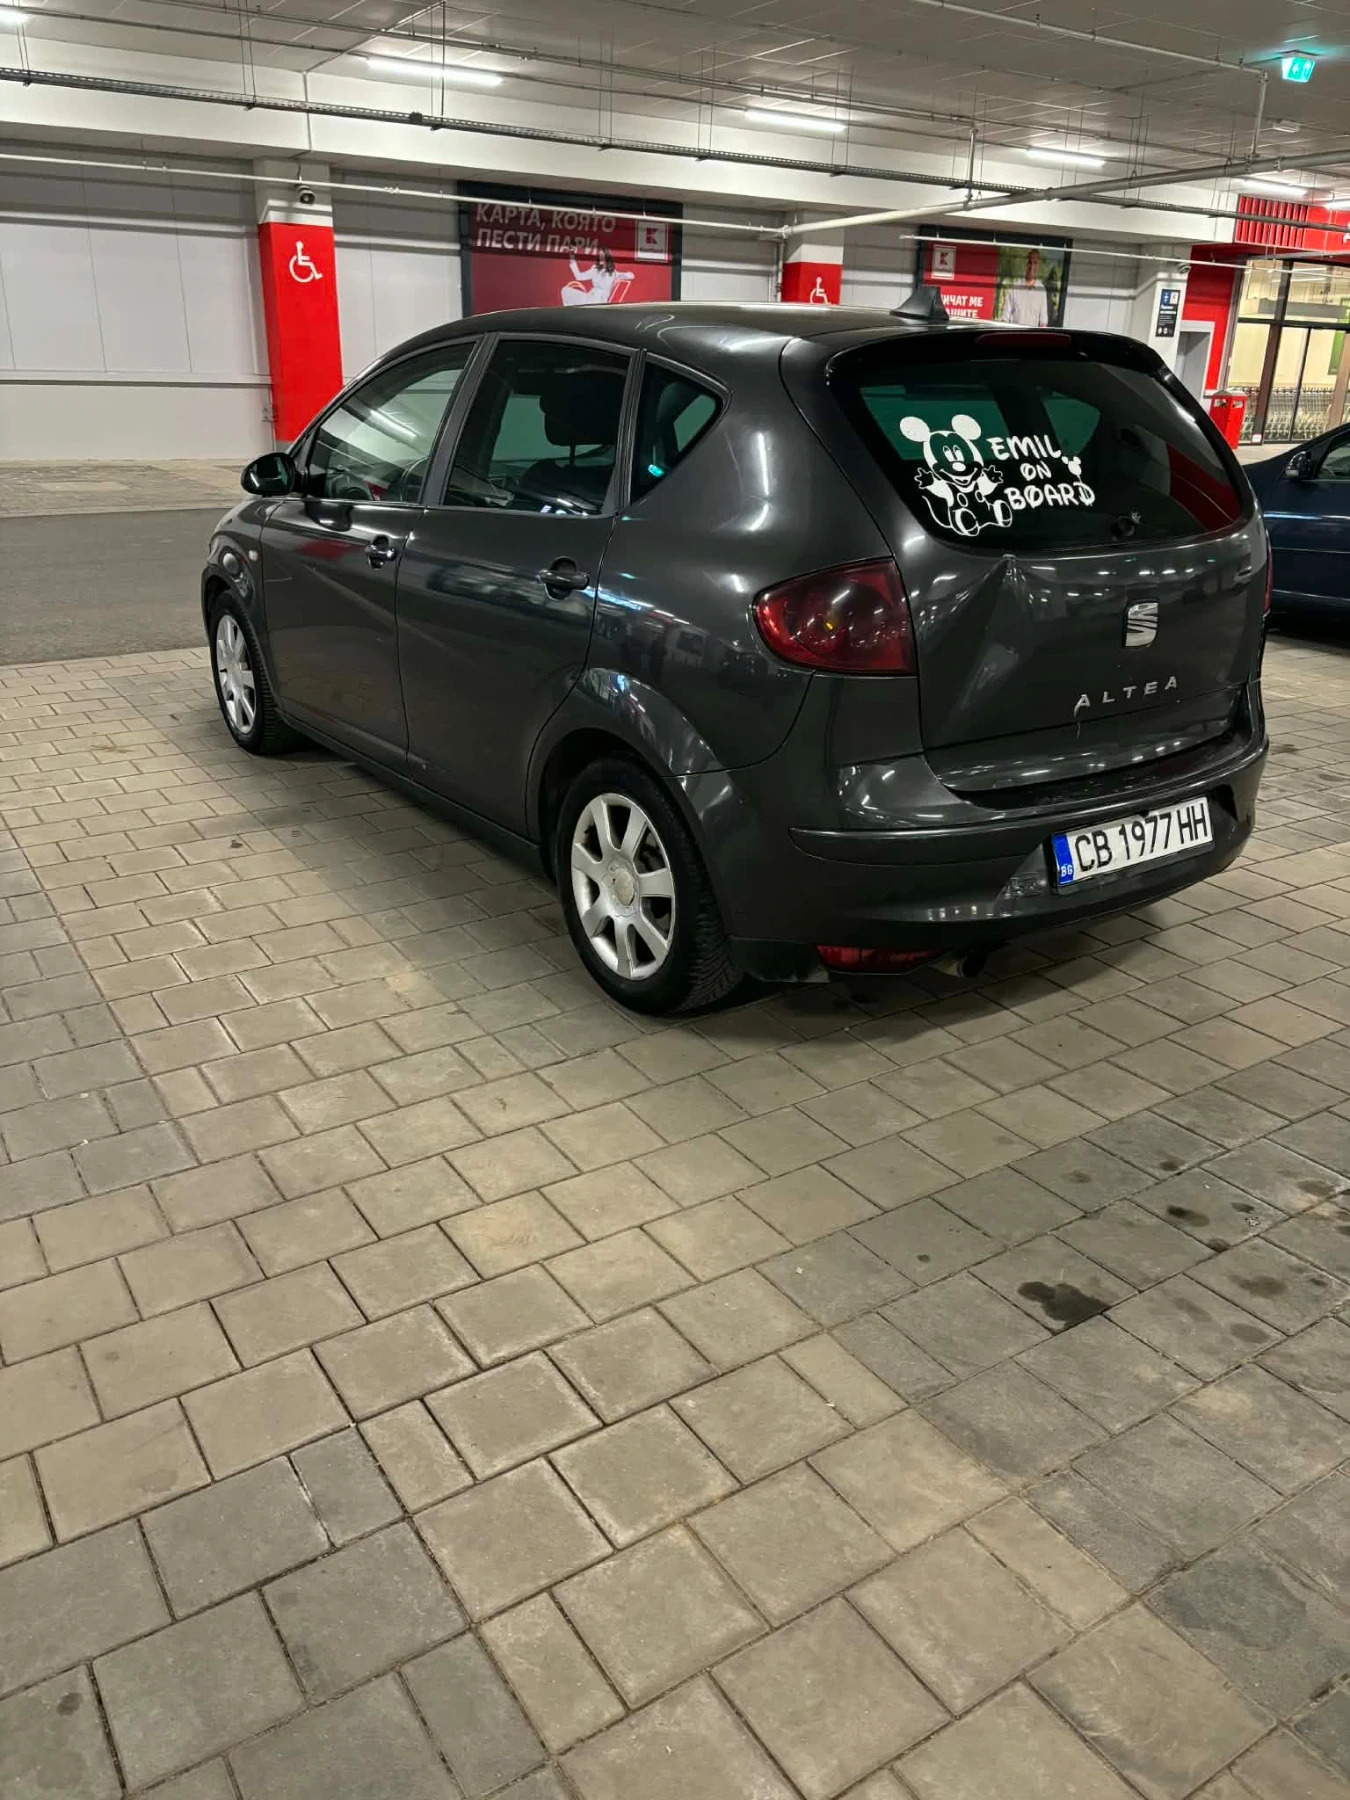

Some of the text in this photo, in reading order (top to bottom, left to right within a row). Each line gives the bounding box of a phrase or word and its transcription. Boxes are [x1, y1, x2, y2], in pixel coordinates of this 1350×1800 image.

[476, 202, 616, 233] КАРТА, КОЯТО
[477, 228, 599, 256] ПЕСТИ ПАРИ
[941, 294, 984, 308] ИЧАТ МЕ
[986, 435, 1062, 461] EMIL
[1020, 461, 1052, 481] ON
[1004, 482, 1096, 510] BOARD
[1073, 675, 1178, 718] ALTEA
[1075, 830, 1113, 872] CB
[1119, 812, 1172, 860] 1977
[1060, 864, 1073, 877] BG
